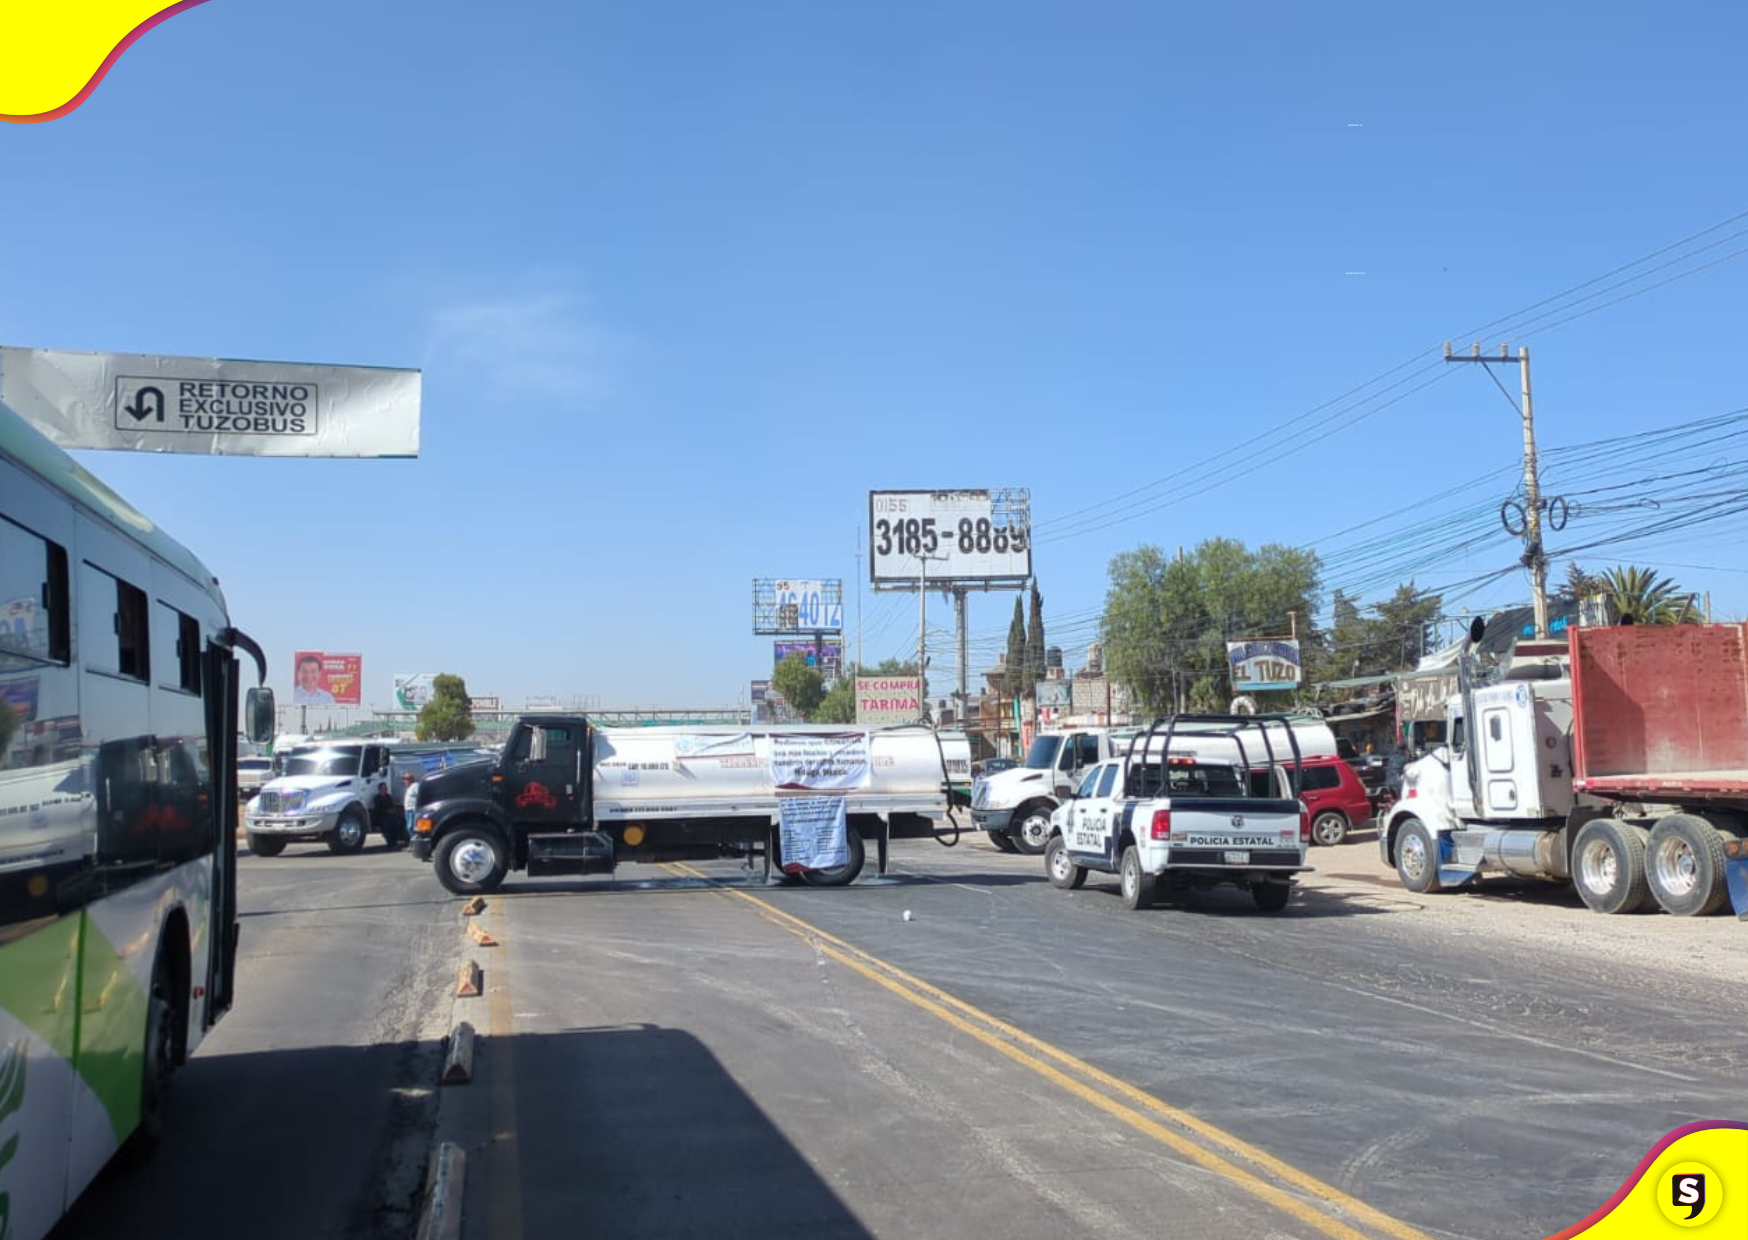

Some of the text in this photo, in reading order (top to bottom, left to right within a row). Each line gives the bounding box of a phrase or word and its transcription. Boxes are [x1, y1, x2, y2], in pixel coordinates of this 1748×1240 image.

[178, 381, 309, 401] RETORNO
[179, 398, 307, 417] EXCLUSIVO
[180, 414, 306, 433] TUZOBUS
[1254, 659, 1295, 682] TUZO
[861, 698, 919, 711] TARIMA
[1232, 836, 1275, 846] ESTATAL
